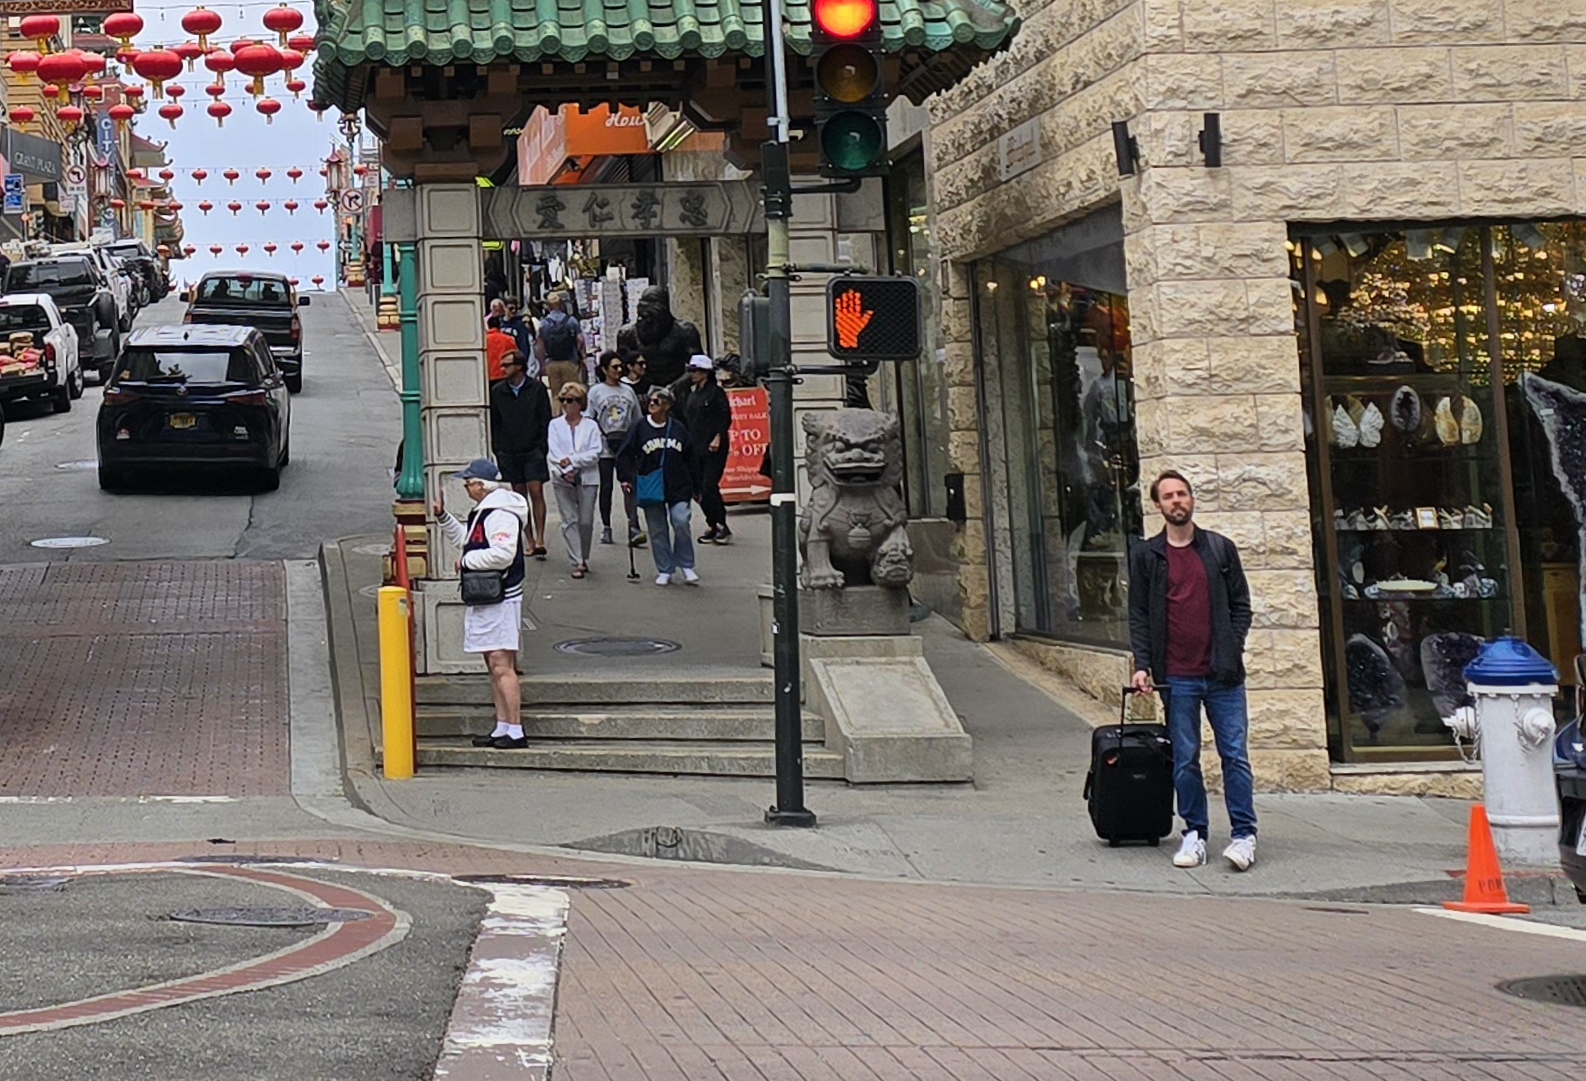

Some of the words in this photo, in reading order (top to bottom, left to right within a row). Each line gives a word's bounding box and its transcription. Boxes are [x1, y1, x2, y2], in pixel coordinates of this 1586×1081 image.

[100, 119, 112, 165] CITY
[728, 429, 739, 442] P
[740, 428, 761, 442] TO
